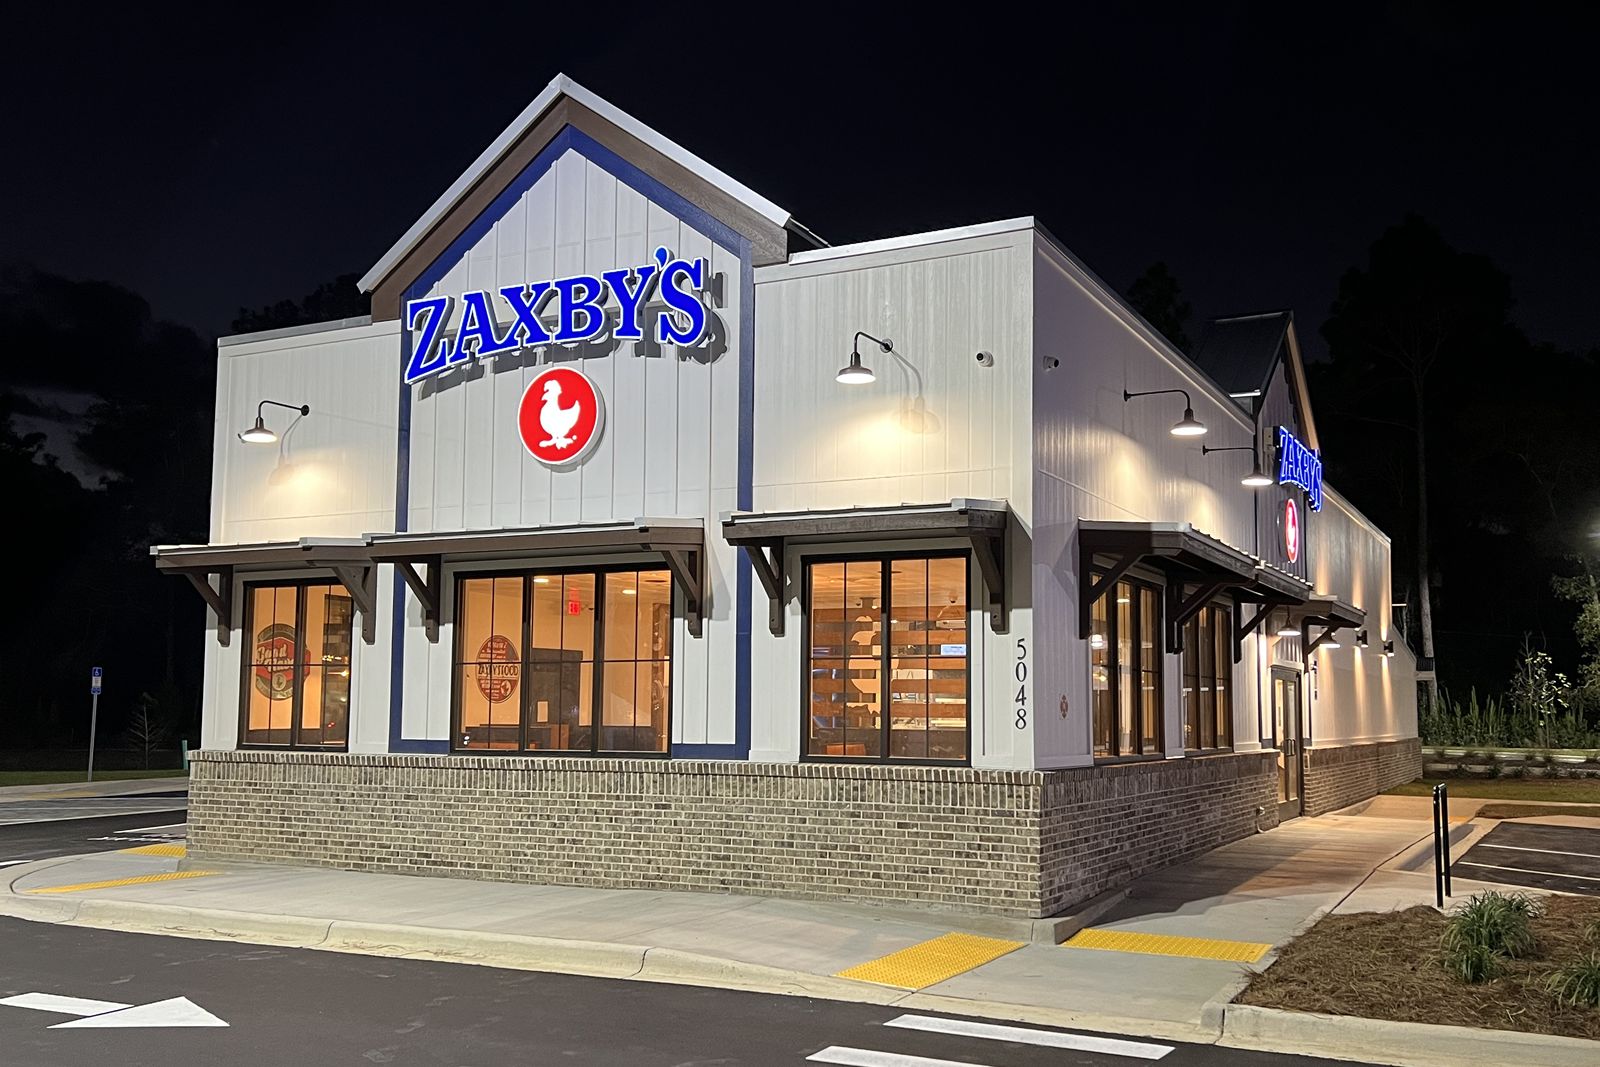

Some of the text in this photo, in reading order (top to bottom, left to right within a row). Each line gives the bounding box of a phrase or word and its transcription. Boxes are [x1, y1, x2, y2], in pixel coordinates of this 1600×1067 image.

[404, 245, 706, 384] ZAXBY'S
[1279, 425, 1322, 513] ZAXBY'S
[1014, 637, 1028, 730] 5048
